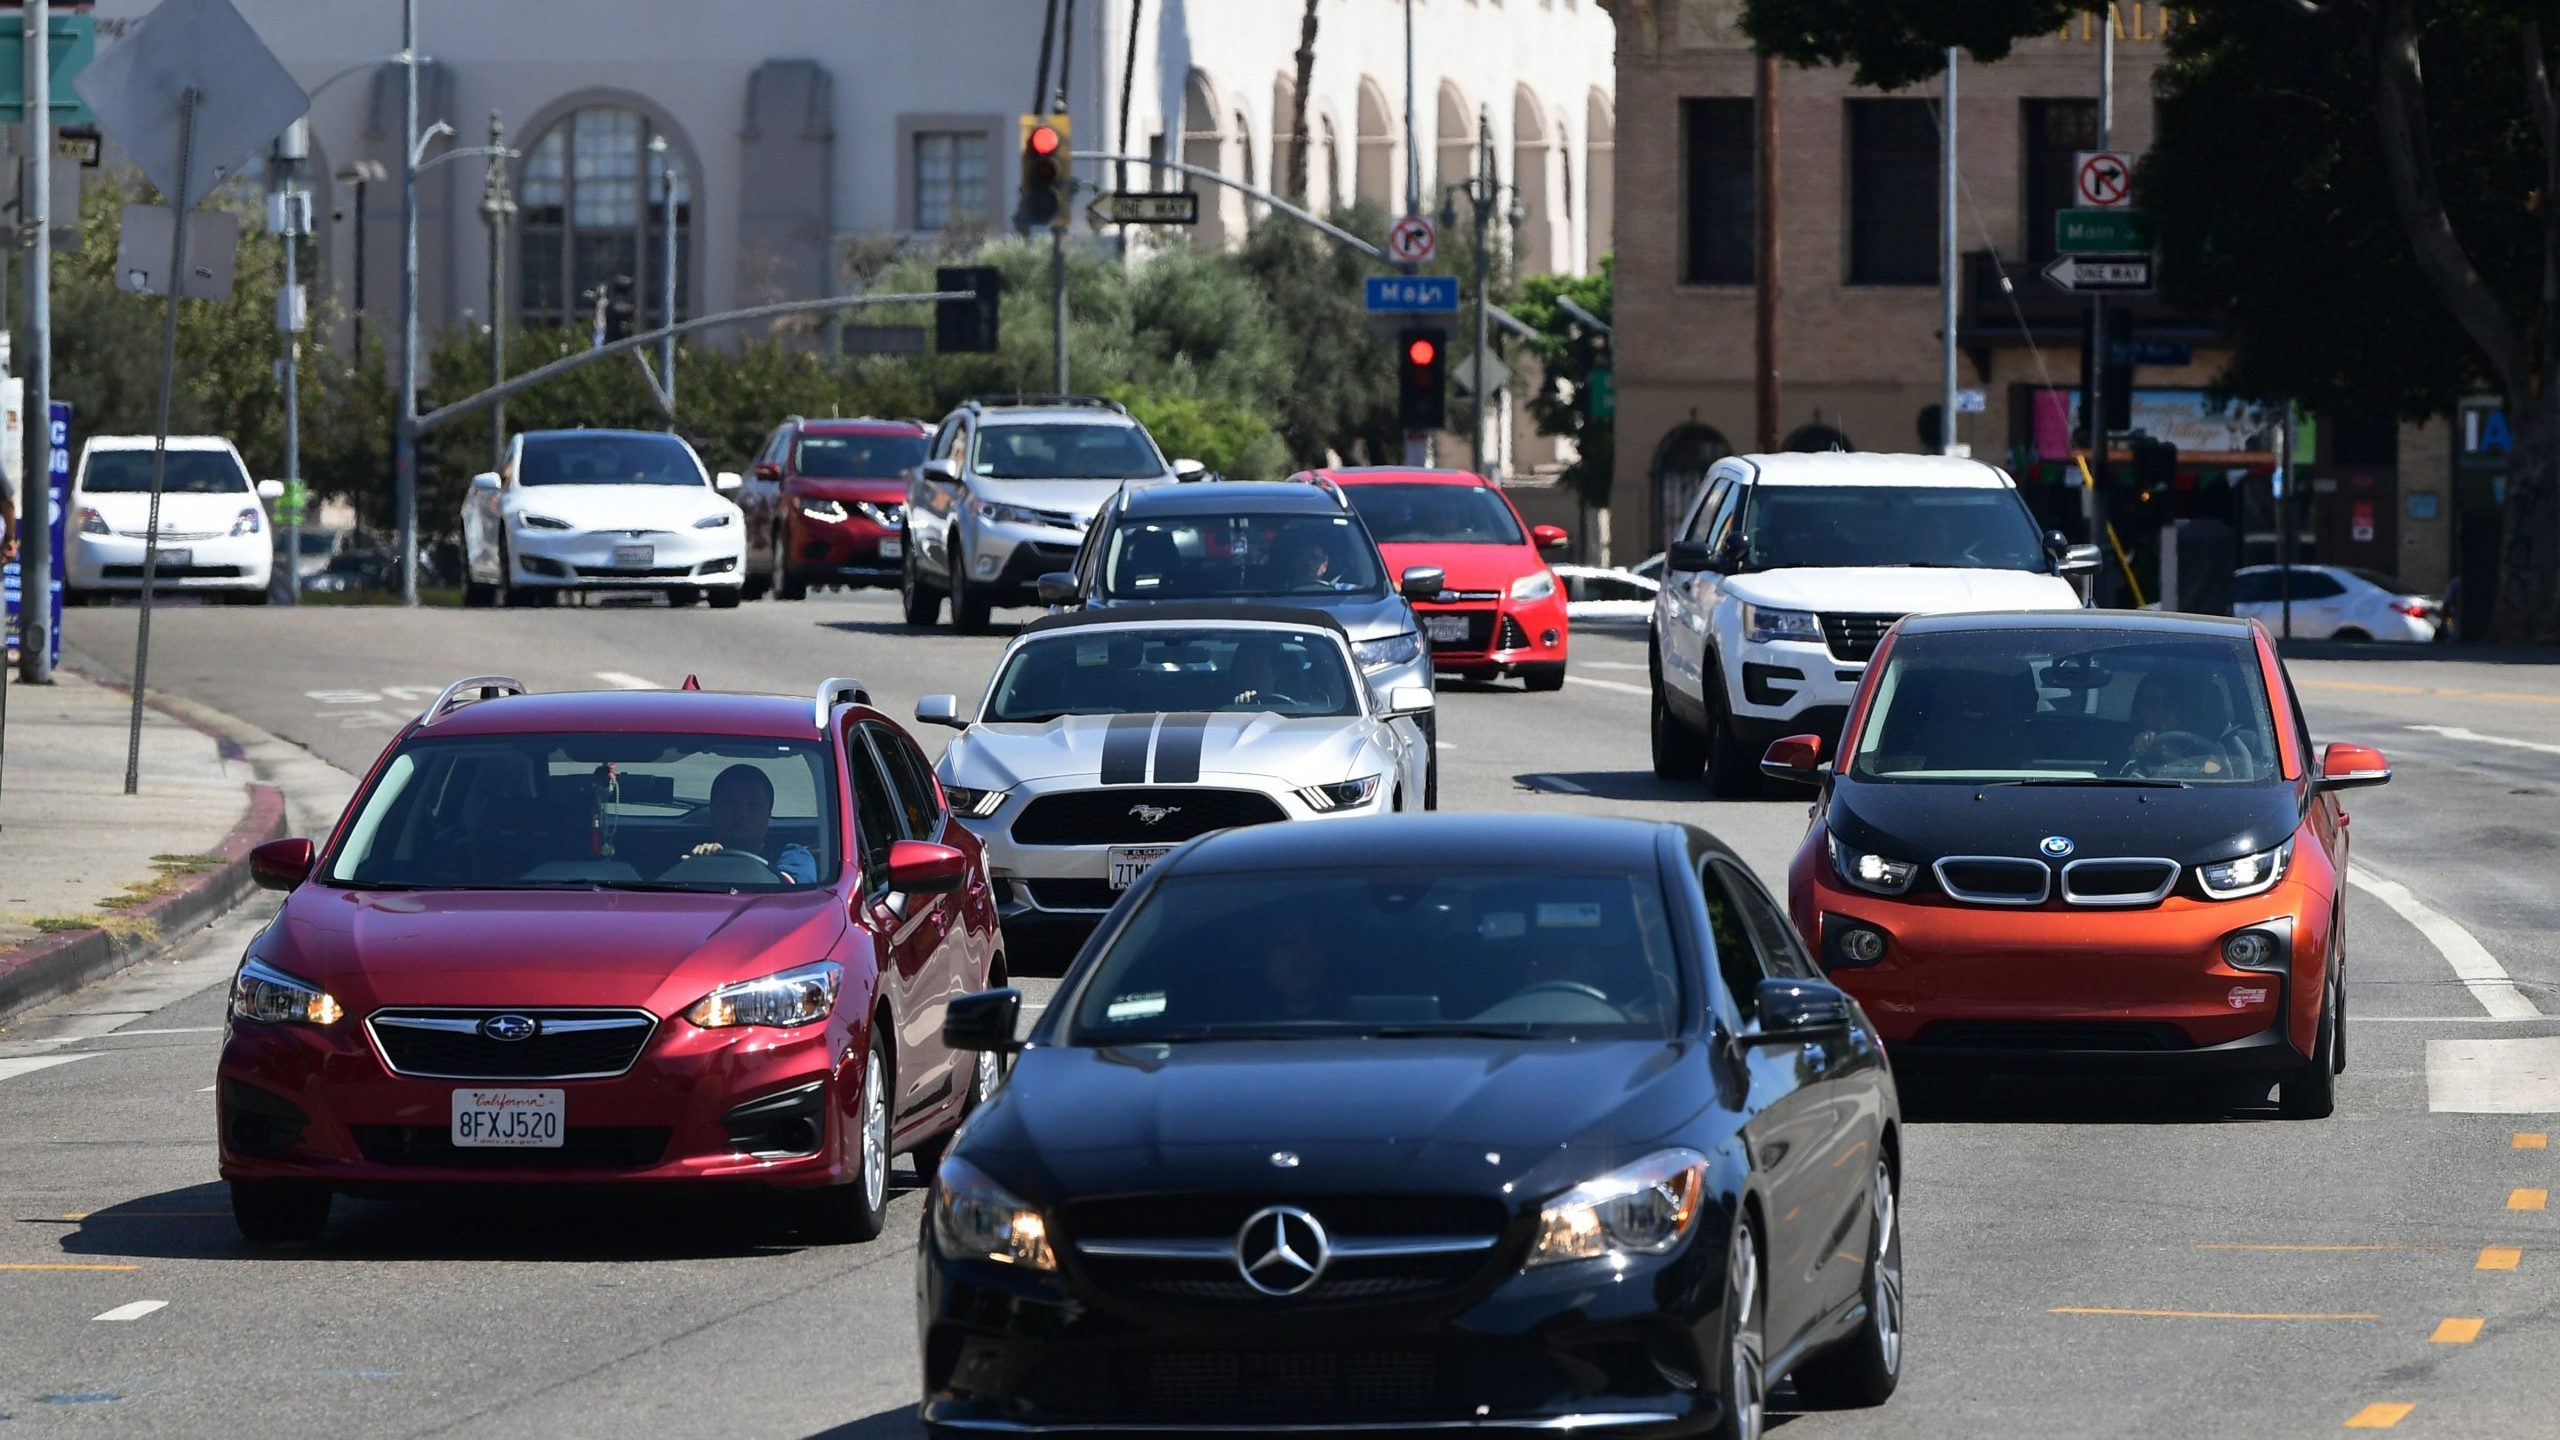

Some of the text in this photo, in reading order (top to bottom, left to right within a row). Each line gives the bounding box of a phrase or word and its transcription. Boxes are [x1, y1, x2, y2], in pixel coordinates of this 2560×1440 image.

[1154, 199, 1185, 218] WAY
[2067, 223, 2115, 240] Main
[2075, 263, 2141, 281] ONE WAY
[1381, 283, 1443, 304] Main
[475, 1093, 544, 1110] California
[460, 1111, 556, 1139] 8FXJ520
